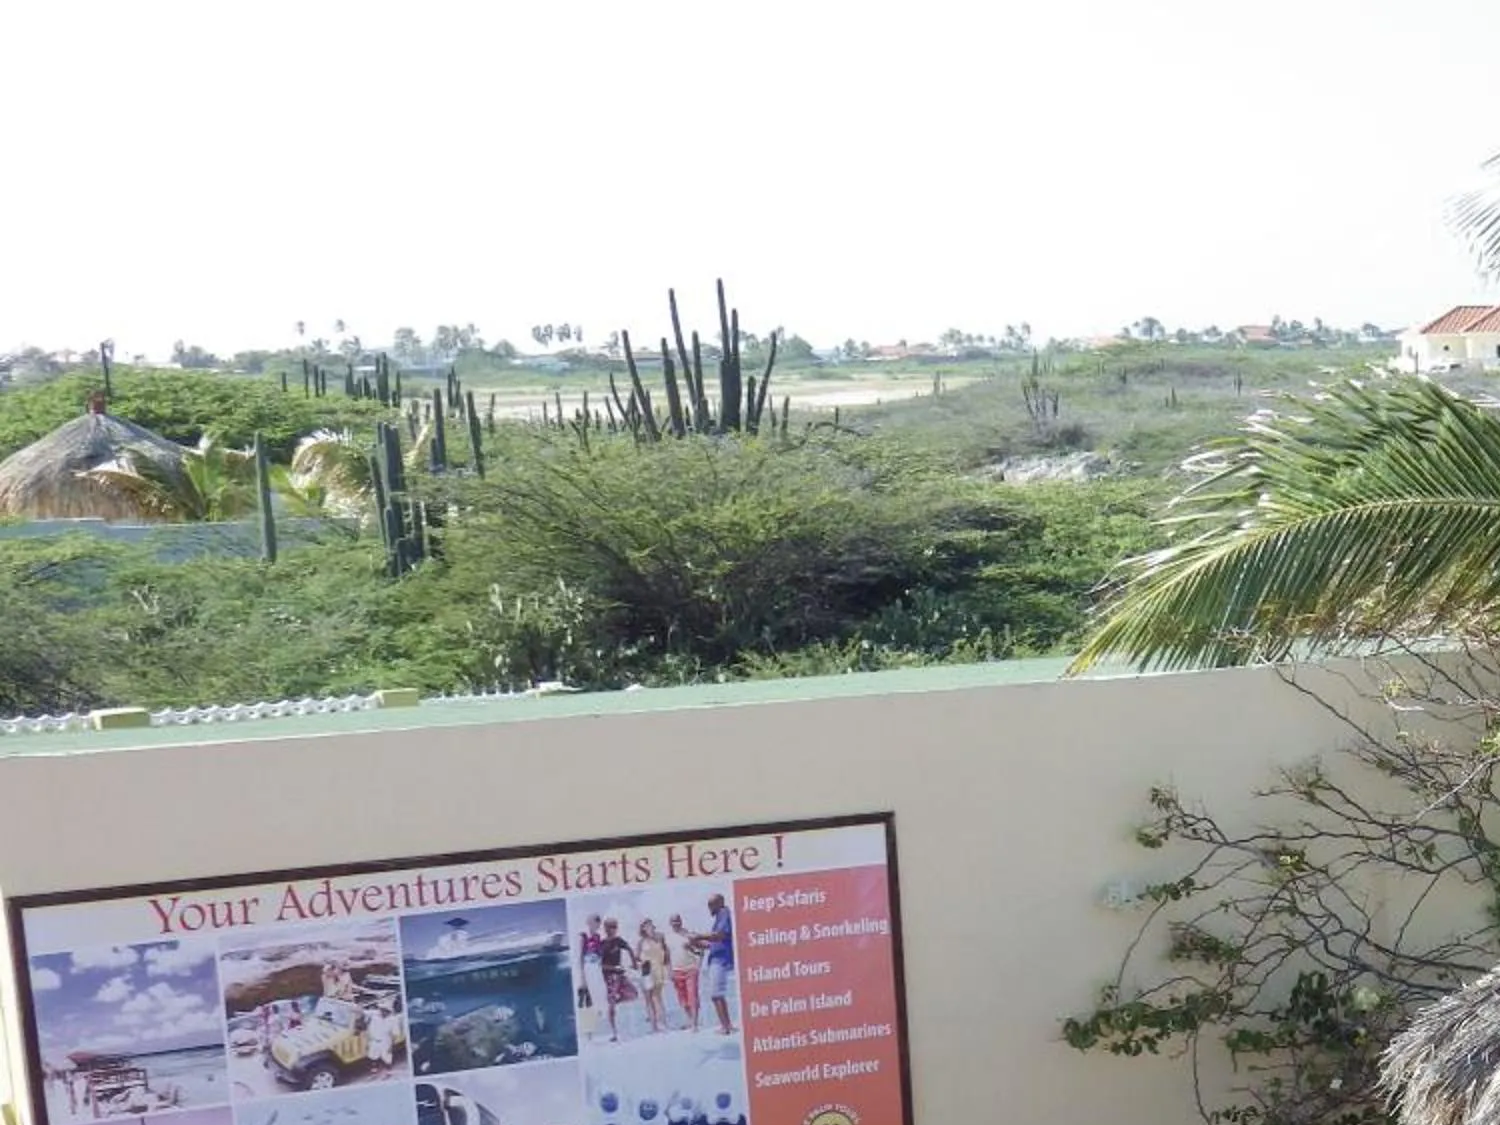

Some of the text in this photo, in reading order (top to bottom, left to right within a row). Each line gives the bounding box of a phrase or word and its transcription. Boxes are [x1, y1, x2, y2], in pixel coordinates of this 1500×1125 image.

[147, 896, 260, 934] Your
[277, 870, 522, 921] Adventures
[536, 852, 650, 893] Starts
[666, 843, 760, 879] Here
[743, 888, 826, 912] Jeep Safaris
[748, 918, 889, 947] Sailing & Snorkeling
[748, 961, 831, 982] Island Tours
[750, 990, 852, 1017] De Palm Island
[753, 1023, 892, 1053] Atlantis Submarines
[755, 1060, 880, 1088] Seaworld Explorer
